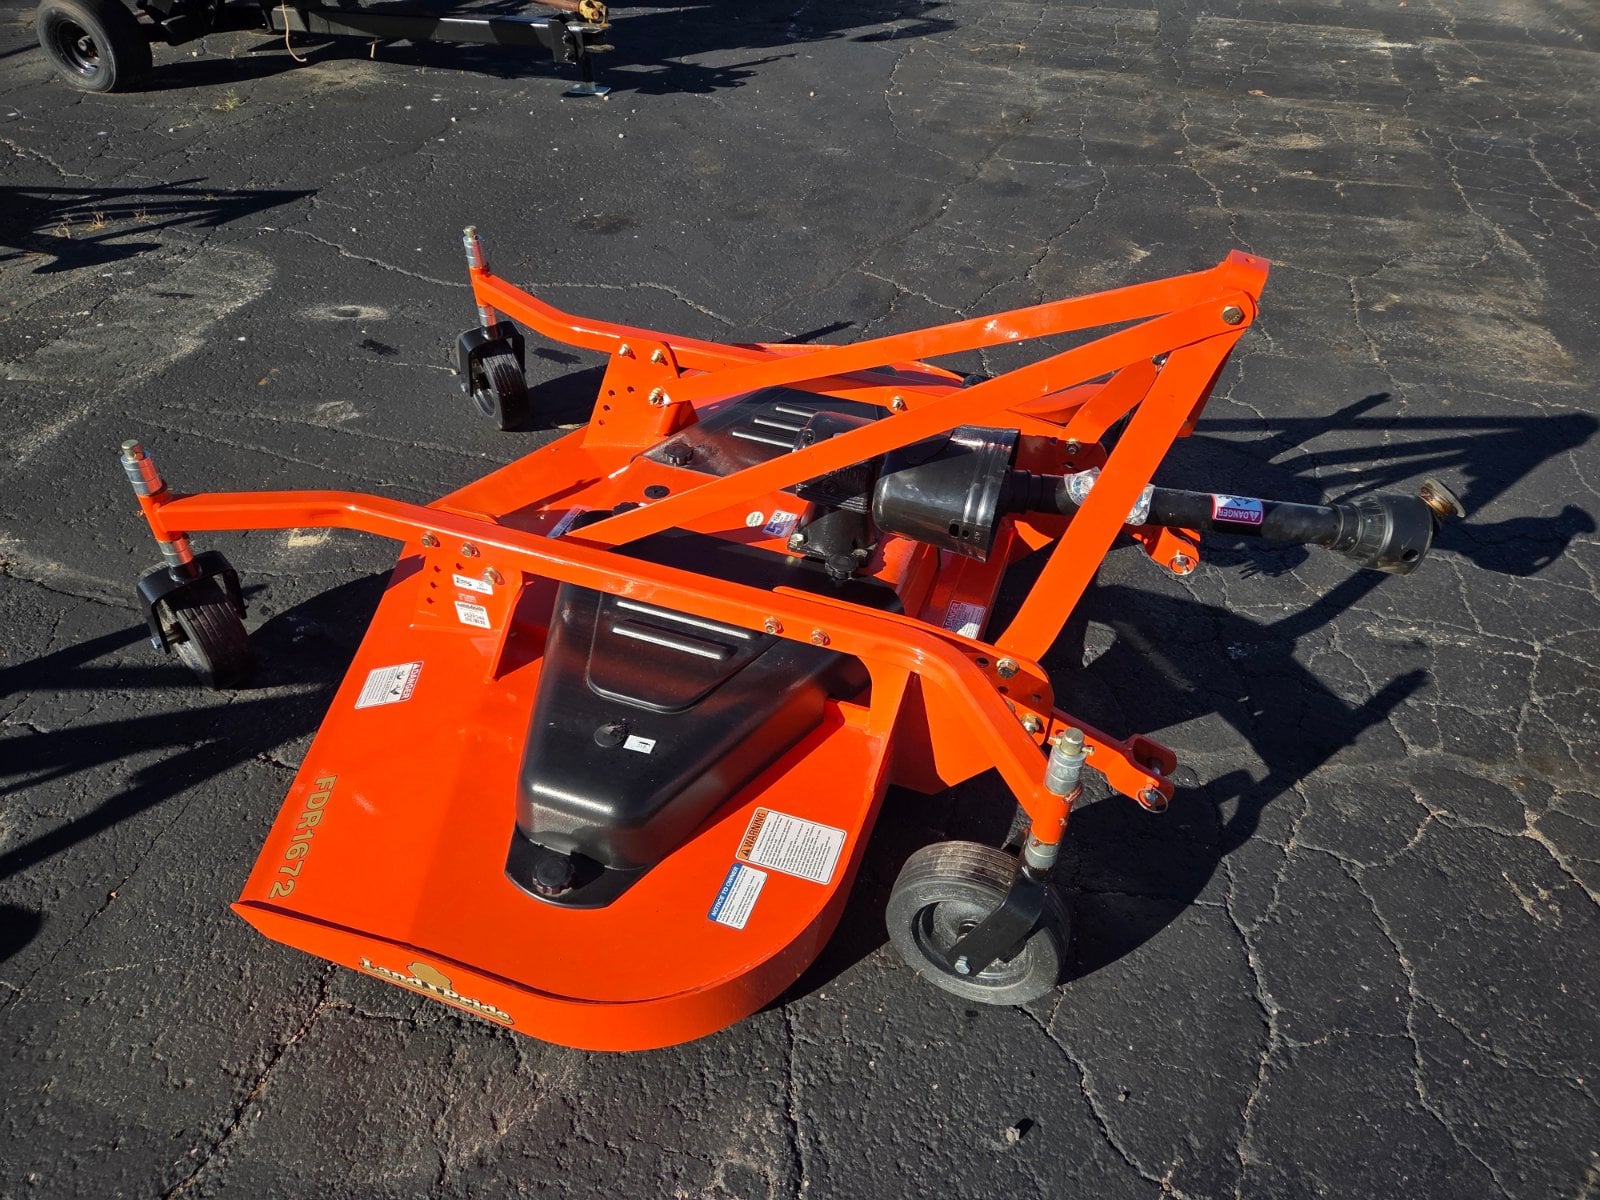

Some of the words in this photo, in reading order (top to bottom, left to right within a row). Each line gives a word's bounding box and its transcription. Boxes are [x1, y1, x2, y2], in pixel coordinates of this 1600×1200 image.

[1217, 507, 1249, 519] DANGER
[400, 667, 420, 700] DANGER
[268, 775, 337, 899] FDR1672
[743, 811, 766, 849] WARNING
[725, 866, 740, 888] OWNER
[722, 884, 730, 896] TO
[711, 895, 727, 918] NOTICE
